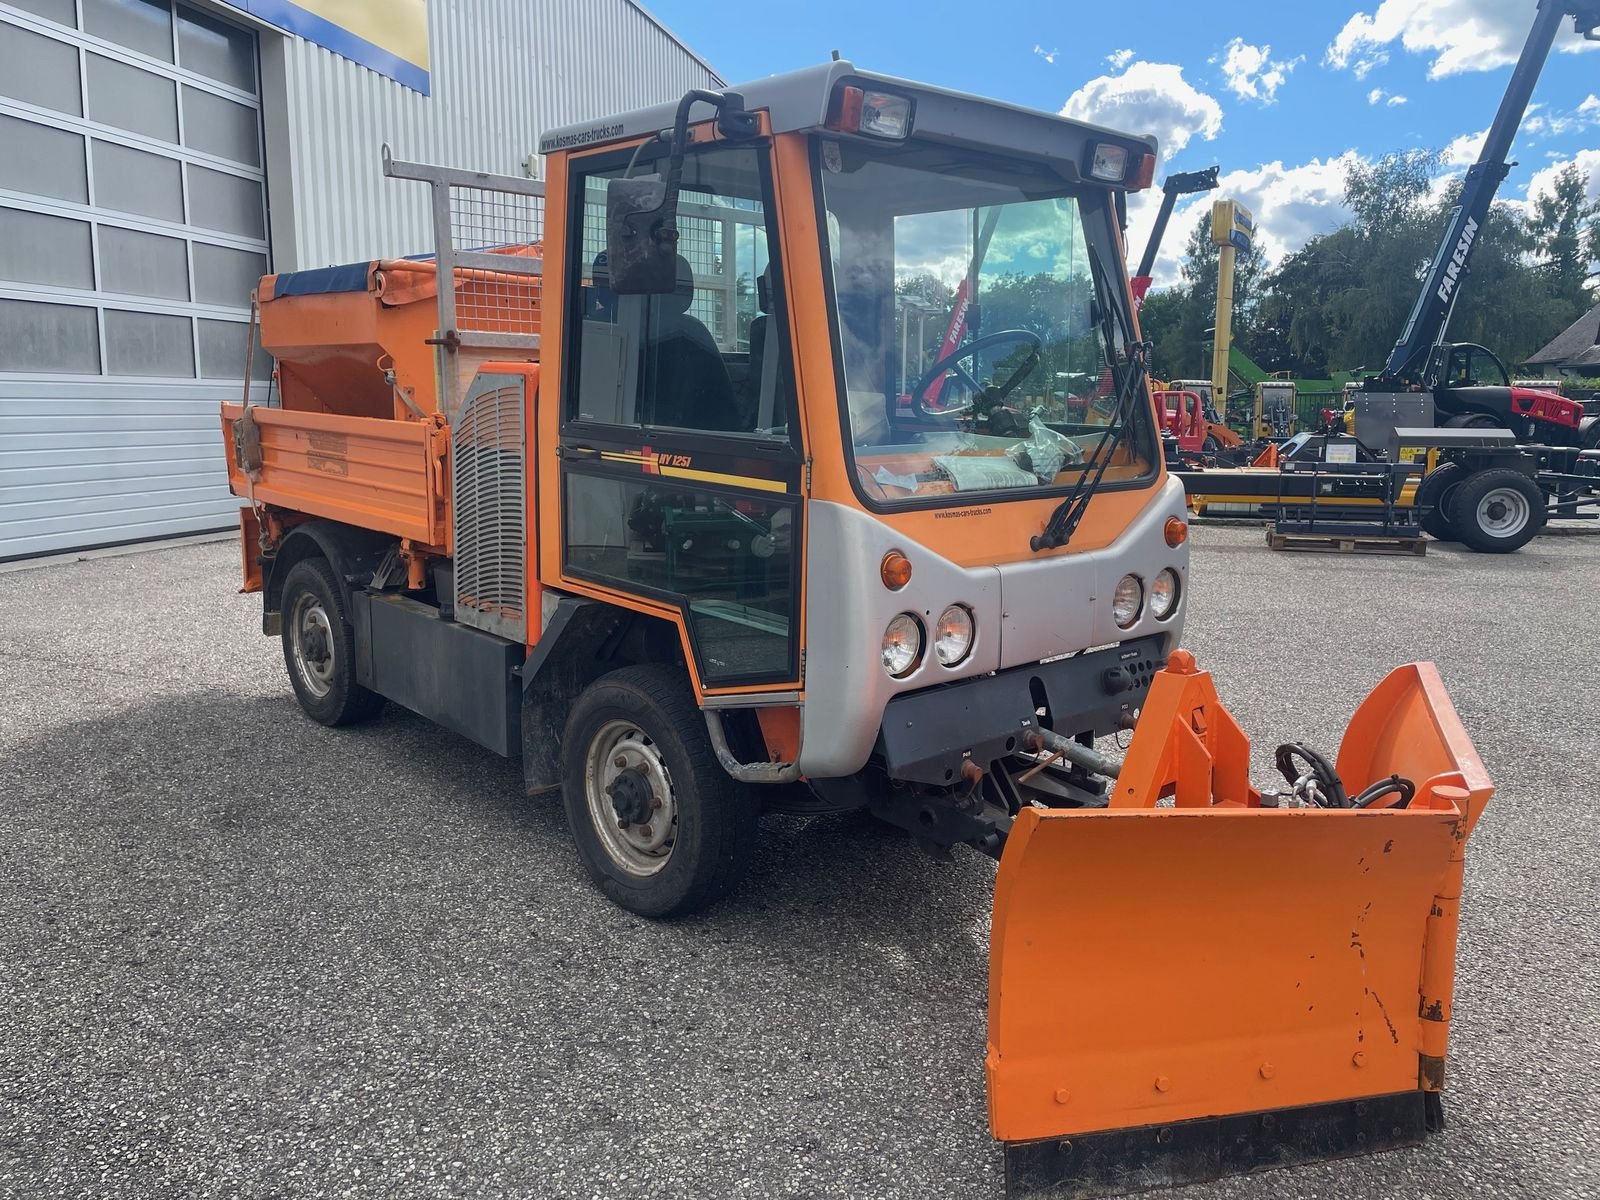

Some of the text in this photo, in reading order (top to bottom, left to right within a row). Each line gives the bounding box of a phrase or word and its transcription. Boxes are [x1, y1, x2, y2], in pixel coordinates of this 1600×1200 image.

[541, 123, 624, 150] www.kosmas-cars-trucks.com
[1437, 216, 1479, 303] FARESIN
[659, 453, 692, 467] HY 1251
